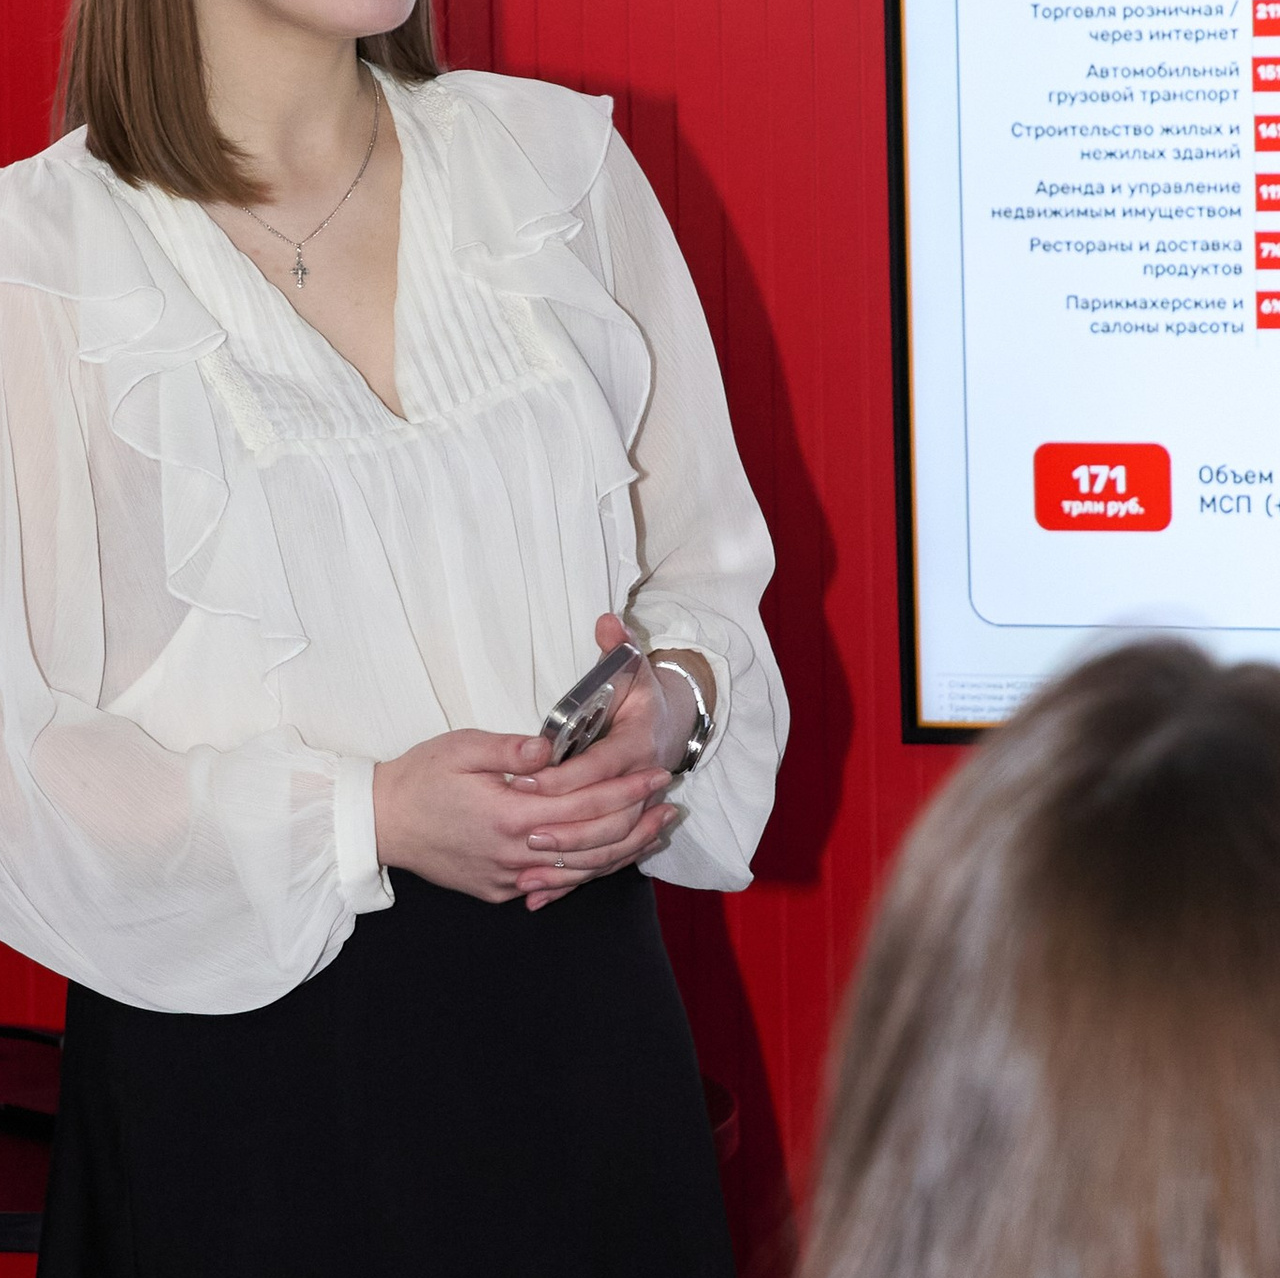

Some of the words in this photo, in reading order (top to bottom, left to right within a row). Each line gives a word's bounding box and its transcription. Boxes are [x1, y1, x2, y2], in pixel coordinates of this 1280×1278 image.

[1031, 3, 1116, 21] Торговля
[1123, 5, 1223, 20] розничная
[1089, 30, 1143, 44] через
[1149, 28, 1238, 43] интернет
[1086, 62, 1239, 79] Автомобильный
[1049, 87, 1134, 106] грузовой
[1141, 89, 1239, 105] транспорт
[1011, 122, 1154, 140] Строительство
[1161, 125, 1222, 136] жилых
[1229, 124, 1241, 135] и
[1081, 149, 1166, 160] нежилых
[1173, 144, 1240, 161] зданий
[1036, 181, 1104, 197] Аренда
[1110, 183, 1122, 195] и
[1128, 182, 1241, 198] управление
[992, 207, 1115, 220] недвижимым
[1122, 206, 1241, 221] имуществом
[1030, 237, 1132, 255] Рестораны
[1138, 241, 1150, 252] и
[1155, 240, 1242, 253] доставка
[1143, 264, 1242, 278] продуктов
[1067, 295, 1226, 312] Парикмахерские
[1232, 299, 1244, 310] и
[1090, 322, 1159, 334] салоны
[1166, 322, 1244, 336] красоты
[1072, 465, 1126, 494] 171
[1199, 465, 1273, 484] Объем
[1062, 500, 1104, 517] трлн
[1106, 497, 1144, 517] руб.
[1200, 495, 1251, 514] МСП
